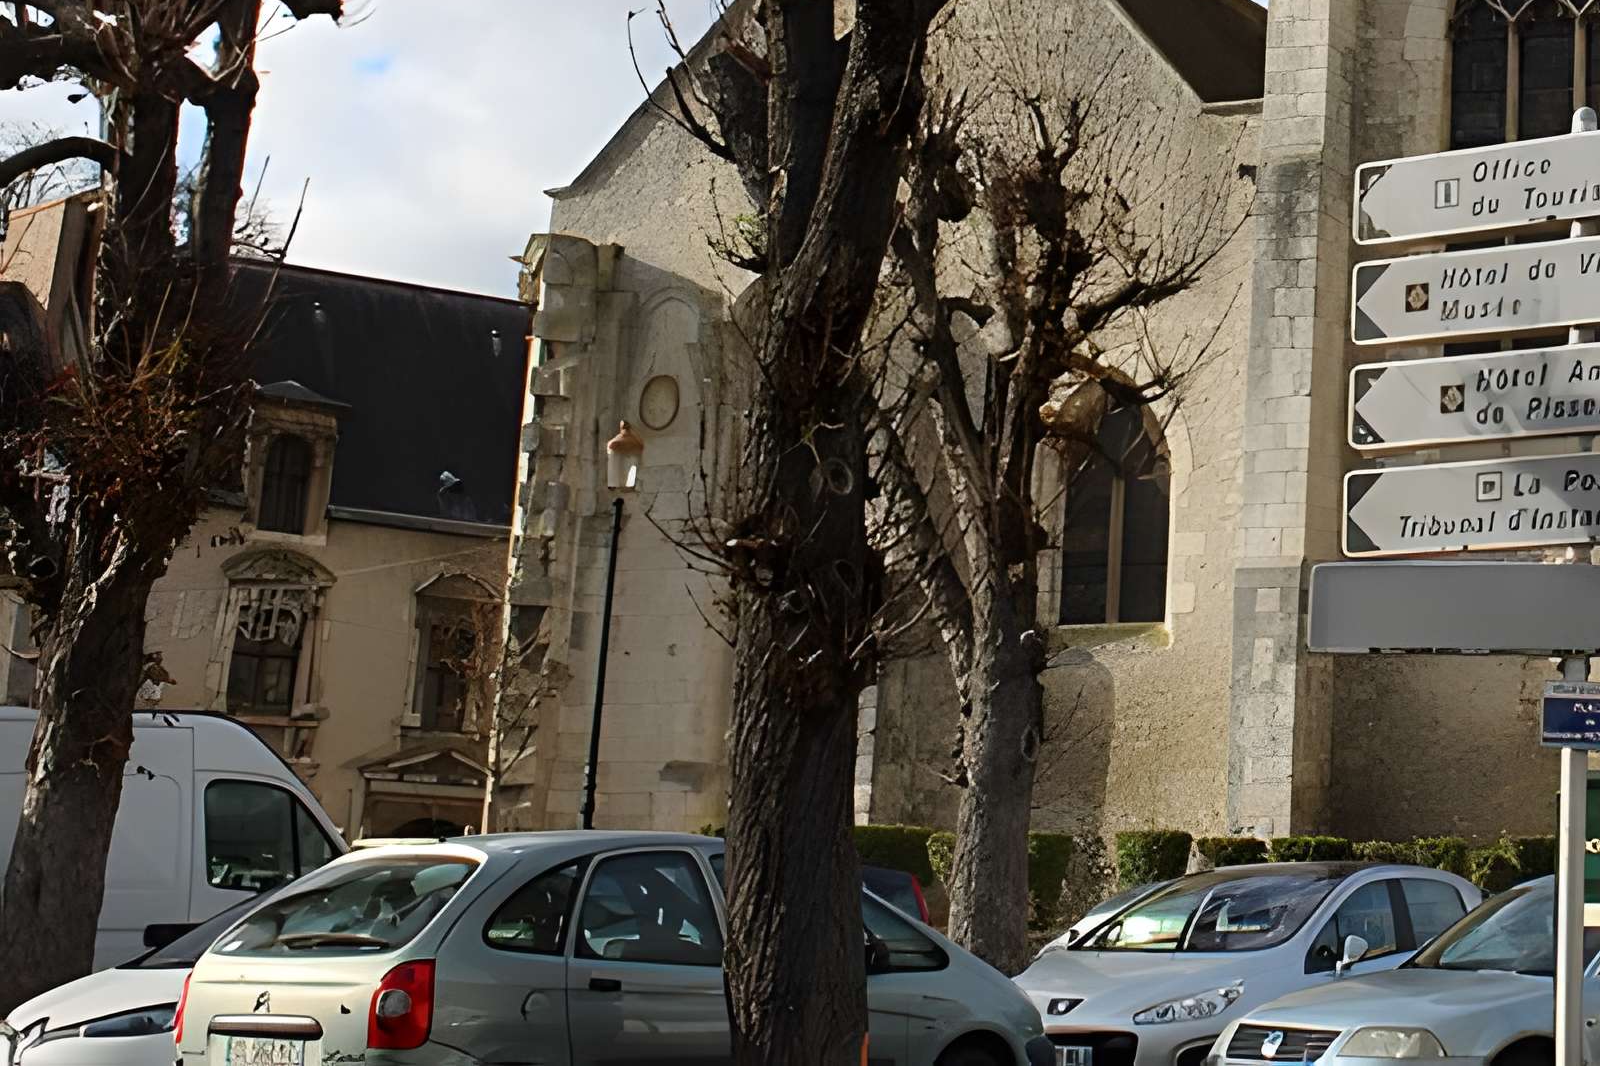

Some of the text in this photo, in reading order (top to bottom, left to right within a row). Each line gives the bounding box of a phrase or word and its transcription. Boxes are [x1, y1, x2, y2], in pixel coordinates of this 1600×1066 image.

[1473, 157, 1551, 182] Office
[1472, 194, 1499, 217] du
[1529, 258, 1556, 281] de
[1476, 402, 1504, 424] de
[1514, 473, 1541, 496] La
[1400, 510, 1496, 538] Tribunal
